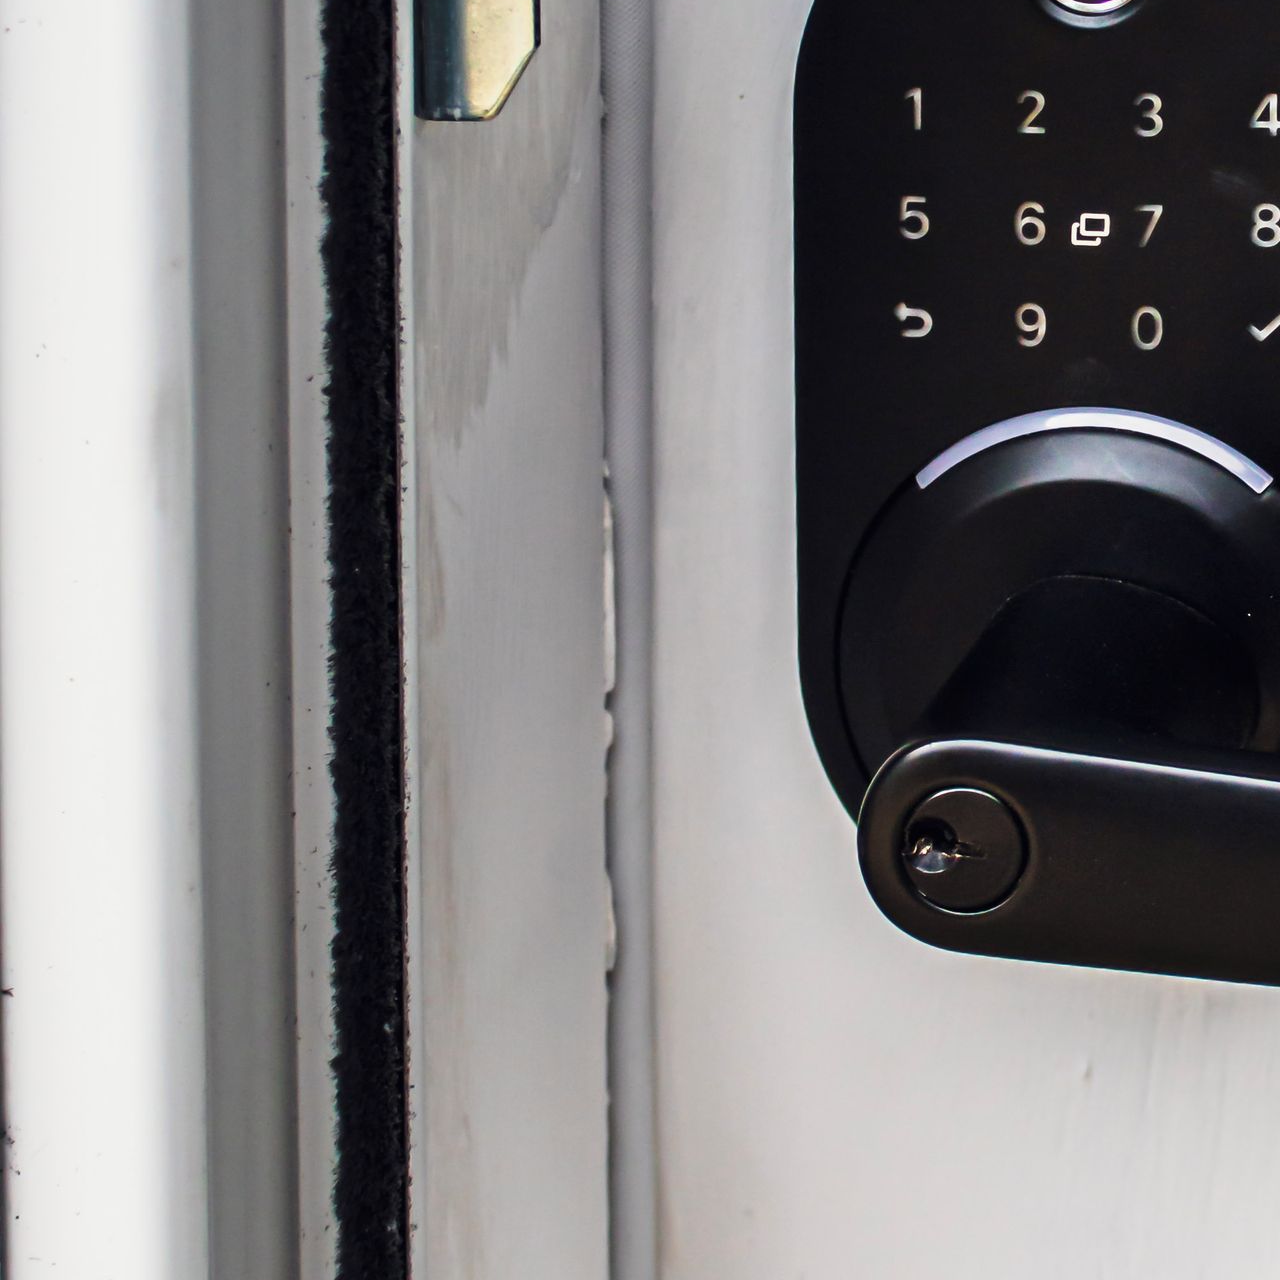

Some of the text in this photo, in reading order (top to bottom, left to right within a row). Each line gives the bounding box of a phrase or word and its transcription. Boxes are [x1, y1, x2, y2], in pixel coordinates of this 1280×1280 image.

[905, 87, 922, 131] 1
[1017, 90, 1046, 135] 2
[1134, 92, 1164, 138] 3
[899, 195, 930, 240] 5
[1014, 201, 1047, 246] 6
[1135, 204, 1164, 248] 7
[1014, 302, 1164, 351] 9 0
